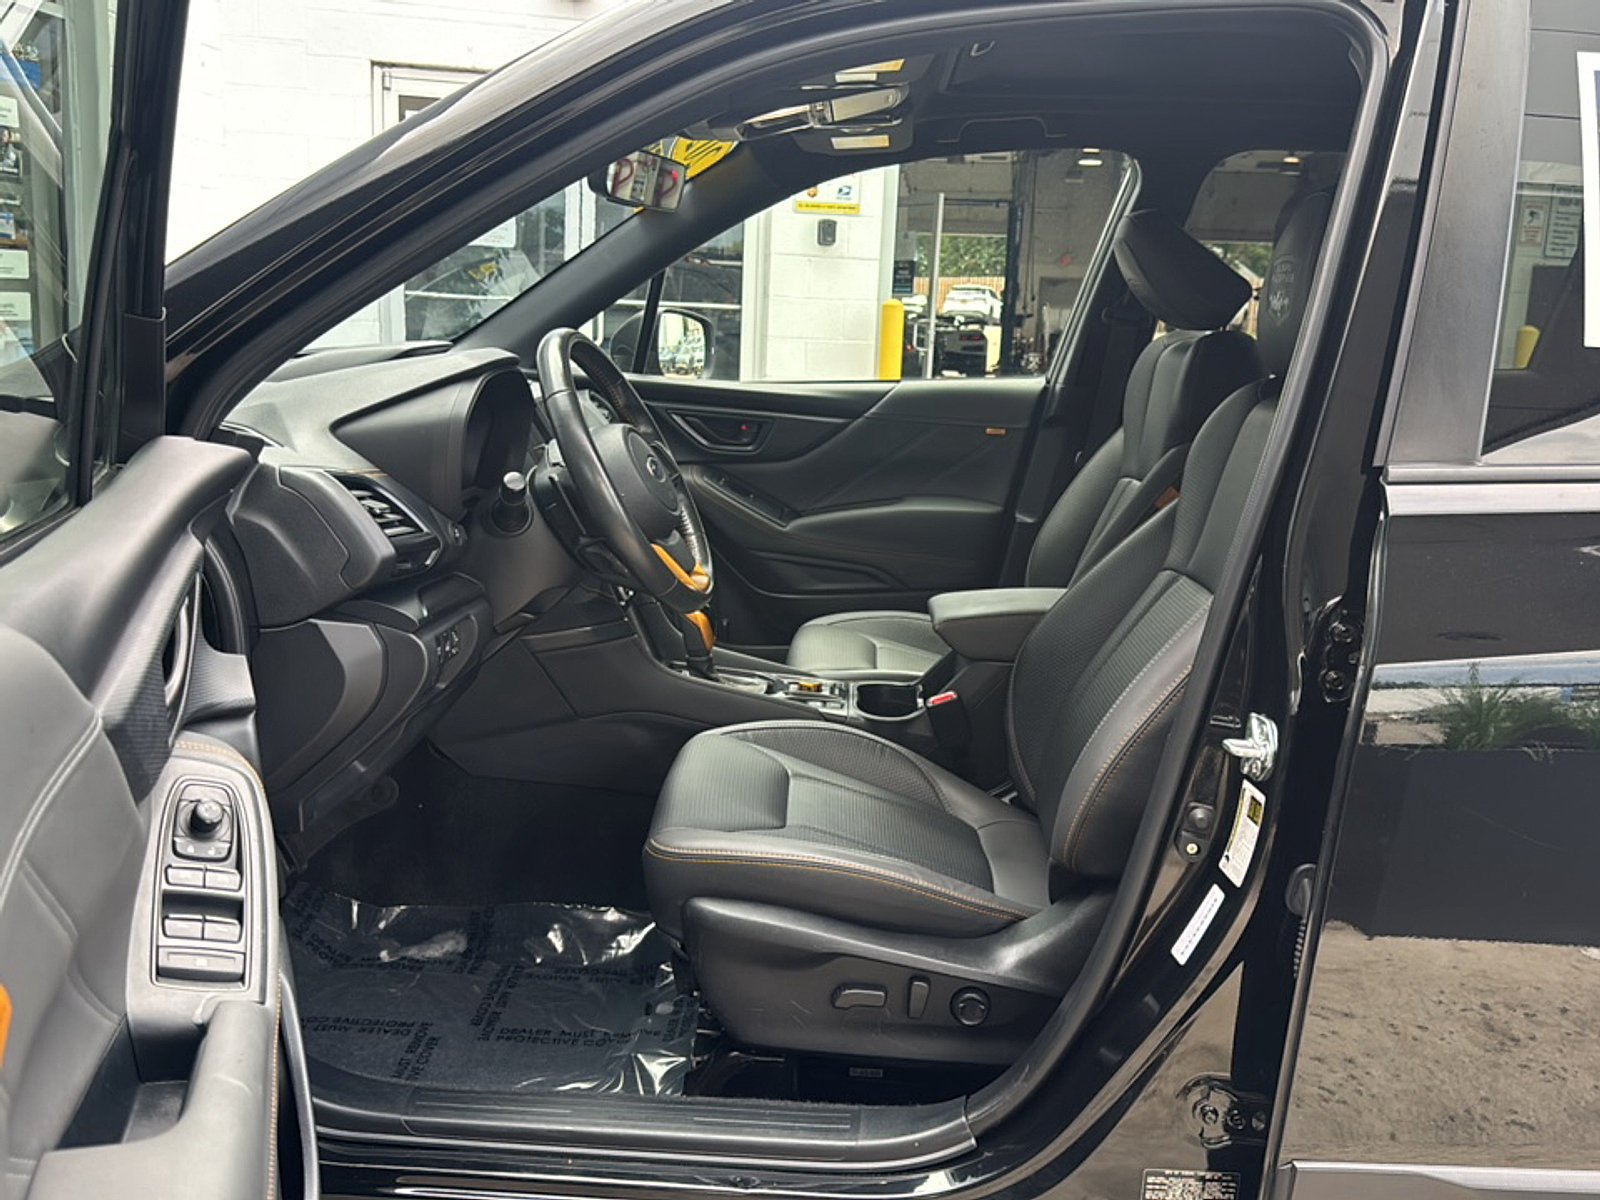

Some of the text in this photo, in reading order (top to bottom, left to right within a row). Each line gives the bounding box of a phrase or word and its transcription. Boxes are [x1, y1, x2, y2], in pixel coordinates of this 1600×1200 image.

[332, 1016, 416, 1028] PROTECTIVE
[312, 1024, 411, 1037] DEALER MUST
[499, 1027, 552, 1036] DEALER
[560, 1029, 596, 1038] MUST
[495, 1034, 582, 1046] PROTECTIVE
